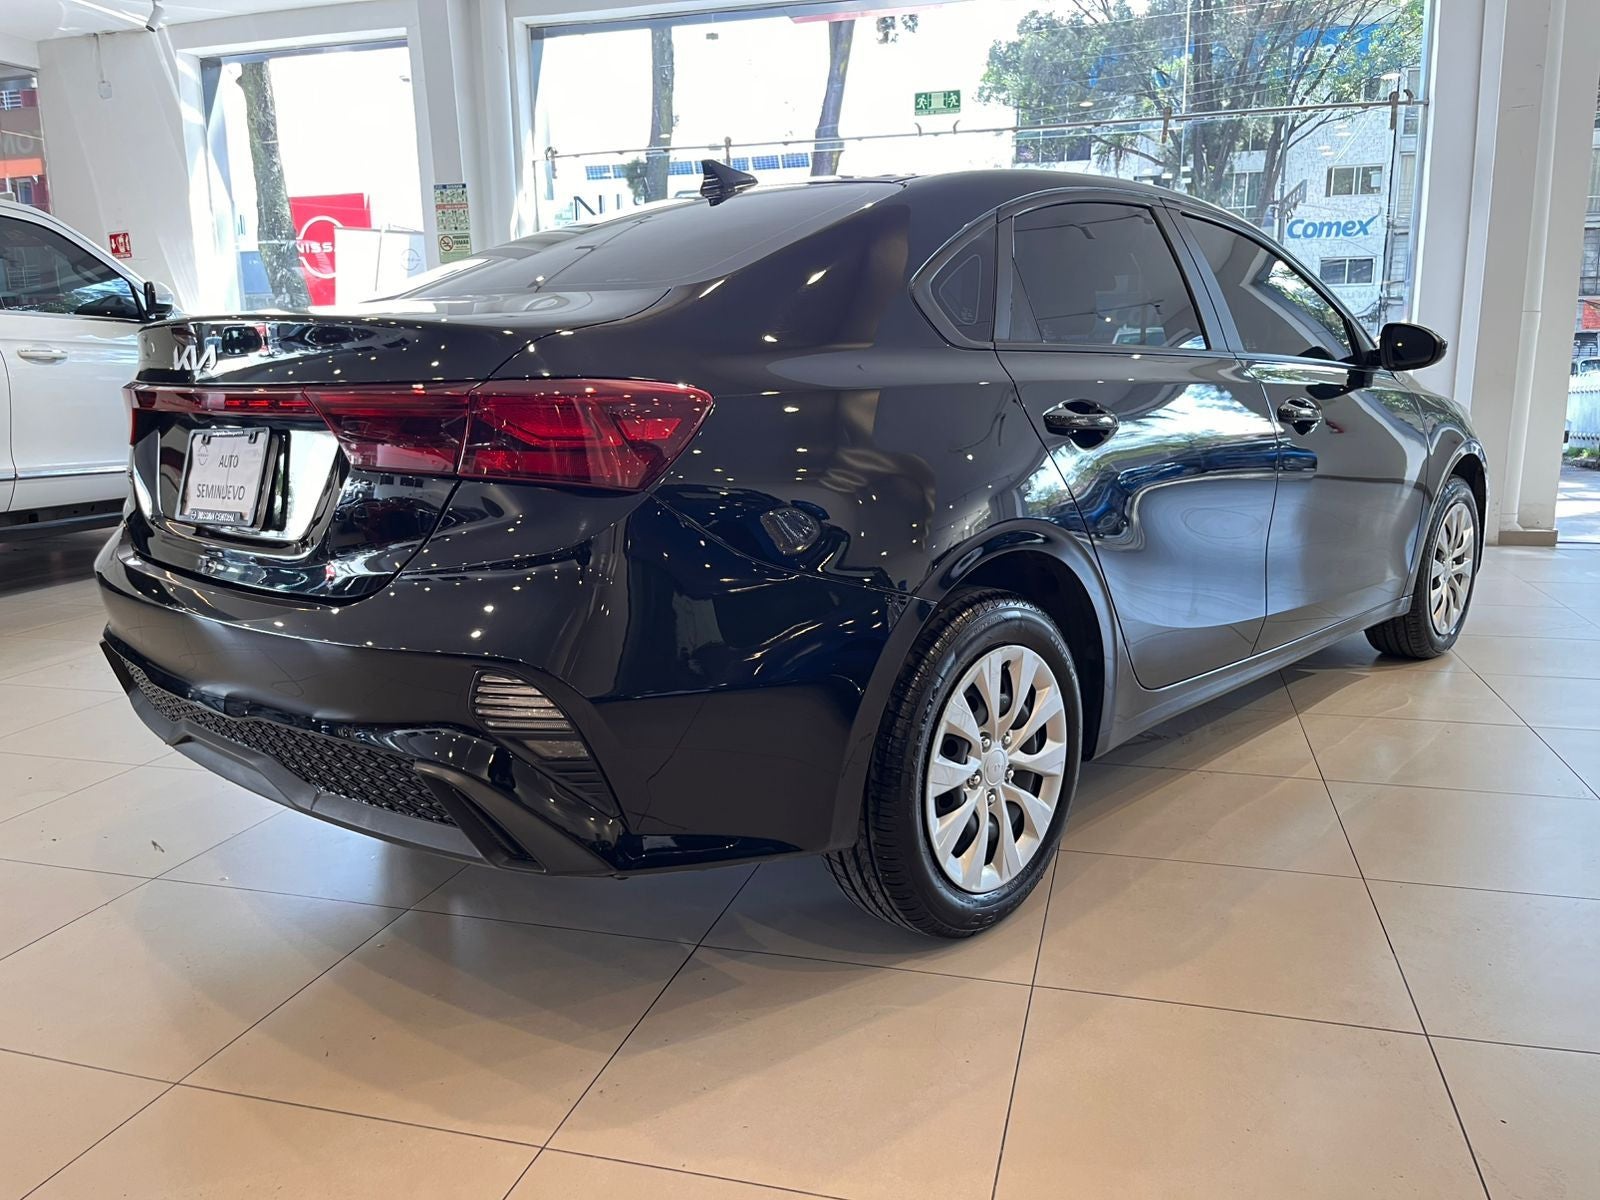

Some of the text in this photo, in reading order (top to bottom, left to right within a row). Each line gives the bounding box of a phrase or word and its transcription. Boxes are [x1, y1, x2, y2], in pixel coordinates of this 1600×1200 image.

[296, 241, 335, 253] NISS
[173, 344, 217, 371] KIA
[218, 454, 239, 468] AUTO
[196, 483, 246, 501] SEMINUEVO
